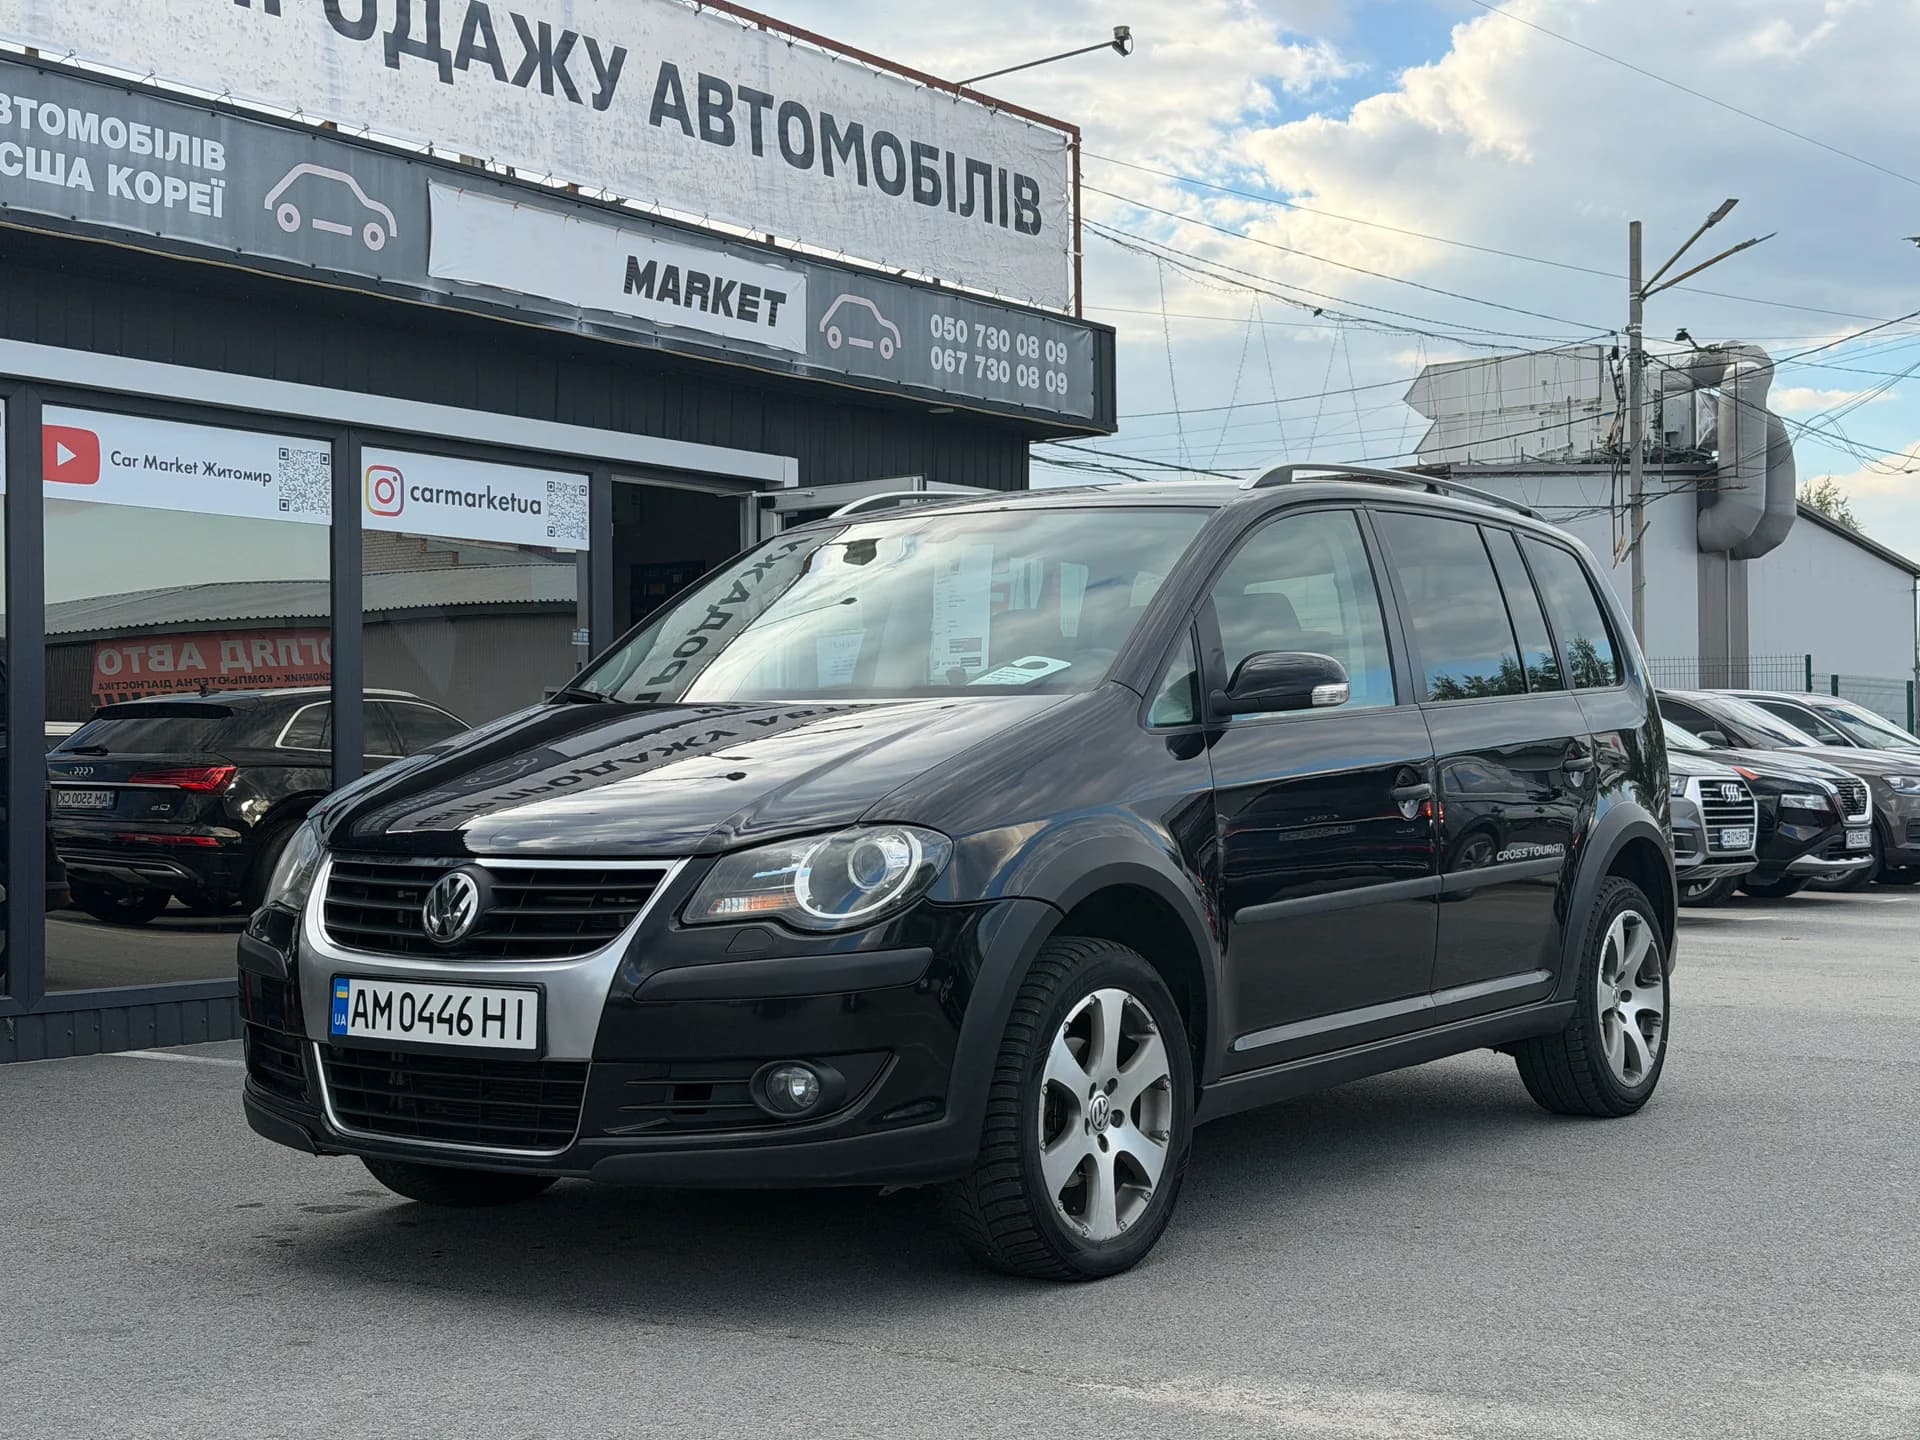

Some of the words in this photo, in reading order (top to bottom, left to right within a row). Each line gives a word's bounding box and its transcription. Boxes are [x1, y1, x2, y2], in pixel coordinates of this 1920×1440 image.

[648, 60, 1042, 236] АВТОМОБІЛІВ
[0, 141, 95, 193] США
[107, 163, 226, 219] КОРЕЇ
[623, 255, 787, 327] MARKET
[930, 313, 968, 344] 050
[974, 323, 1011, 353] 730
[1016, 333, 1040, 359] 08
[1045, 339, 1068, 365] 09
[930, 346, 968, 375] 067
[974, 354, 1011, 383] 730
[1016, 363, 1040, 390] 08
[1045, 369, 1068, 395] 09
[110, 450, 139, 468] Car
[143, 454, 198, 475] Market
[202, 460, 272, 487] Житомир
[409, 484, 542, 515] carmarketua
[334, 1013, 346, 1026] UA
